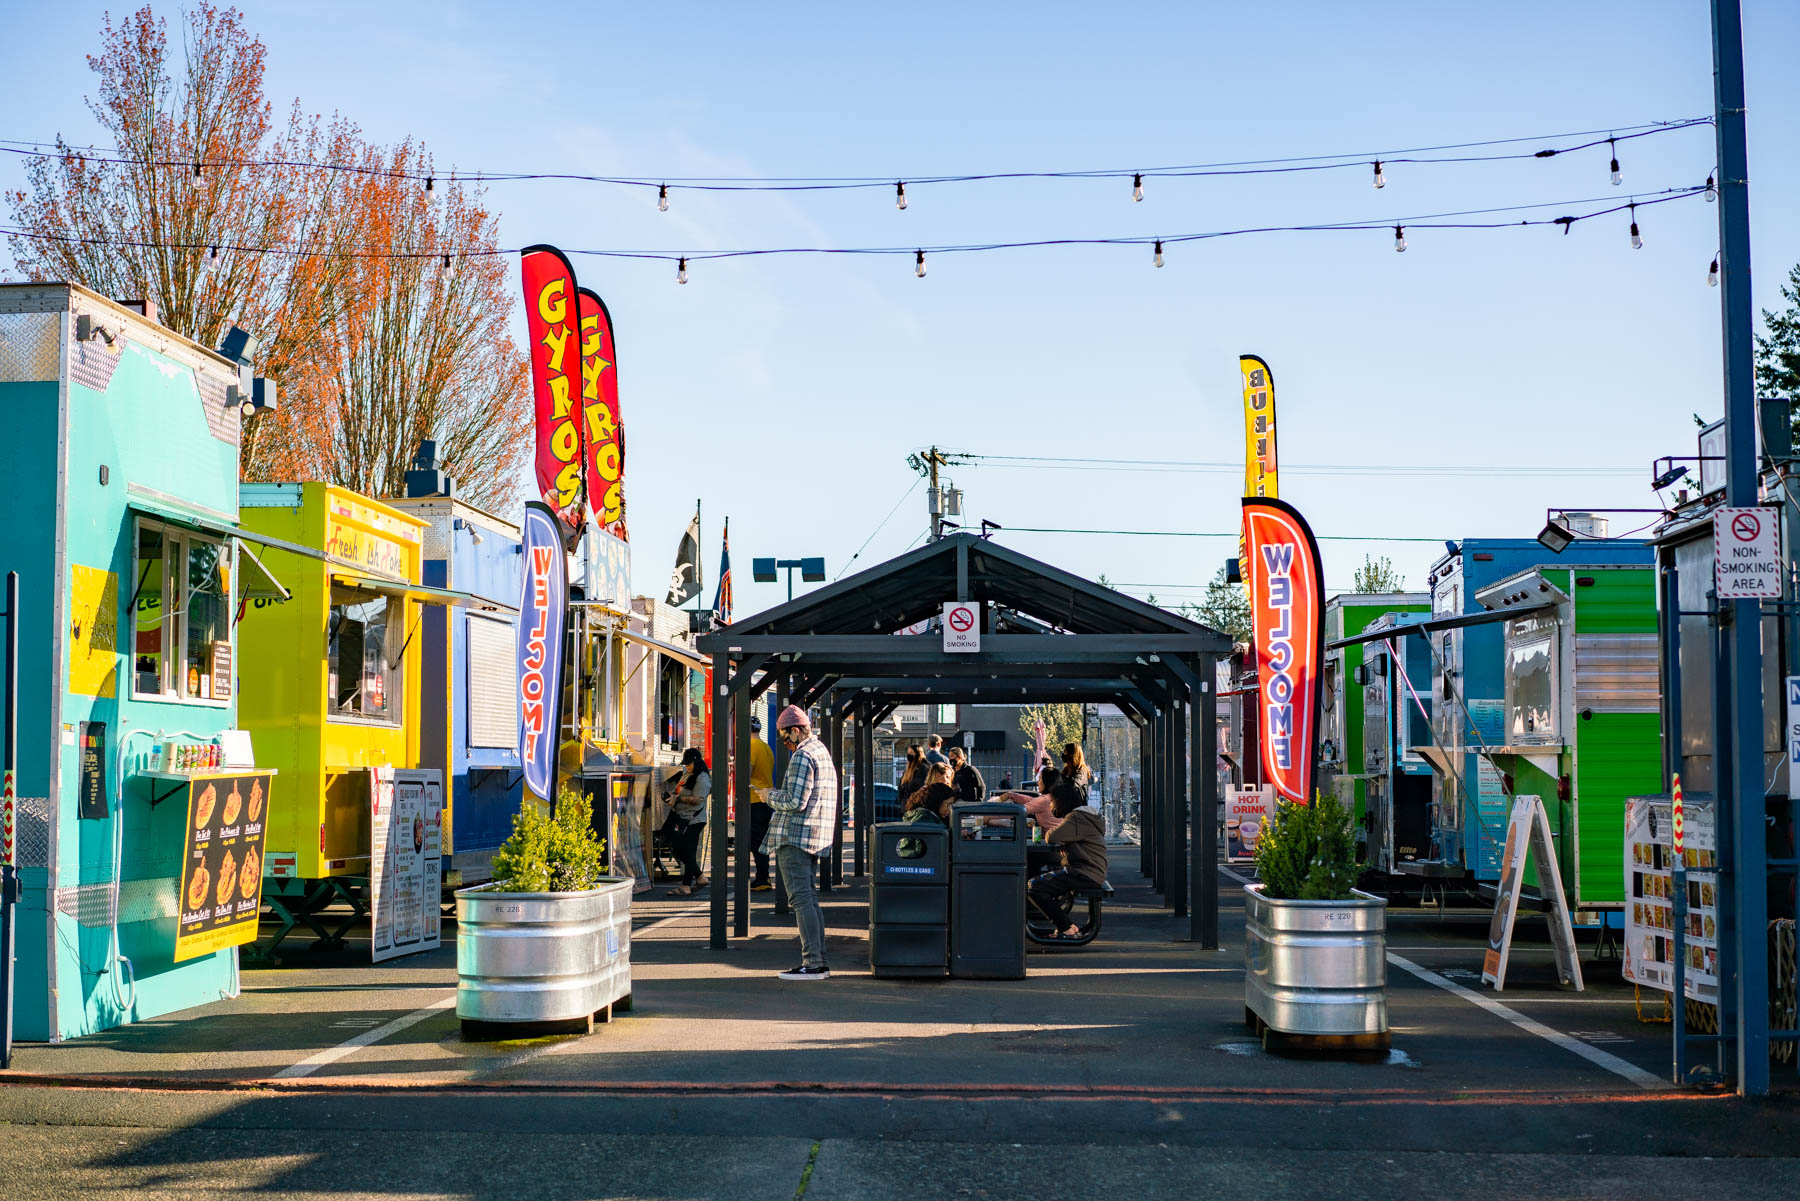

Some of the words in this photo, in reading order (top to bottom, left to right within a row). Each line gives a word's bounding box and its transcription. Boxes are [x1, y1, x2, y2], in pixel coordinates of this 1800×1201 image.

[538, 277, 581, 508] GYROS
[581, 314, 621, 524] GYROS
[1732, 546, 1762, 558] NON-
[1721, 562, 1775, 574] SMOKING
[1731, 578, 1766, 590] AREA
[1237, 795, 1261, 804] HOT
[1232, 805, 1267, 814] DRINK
